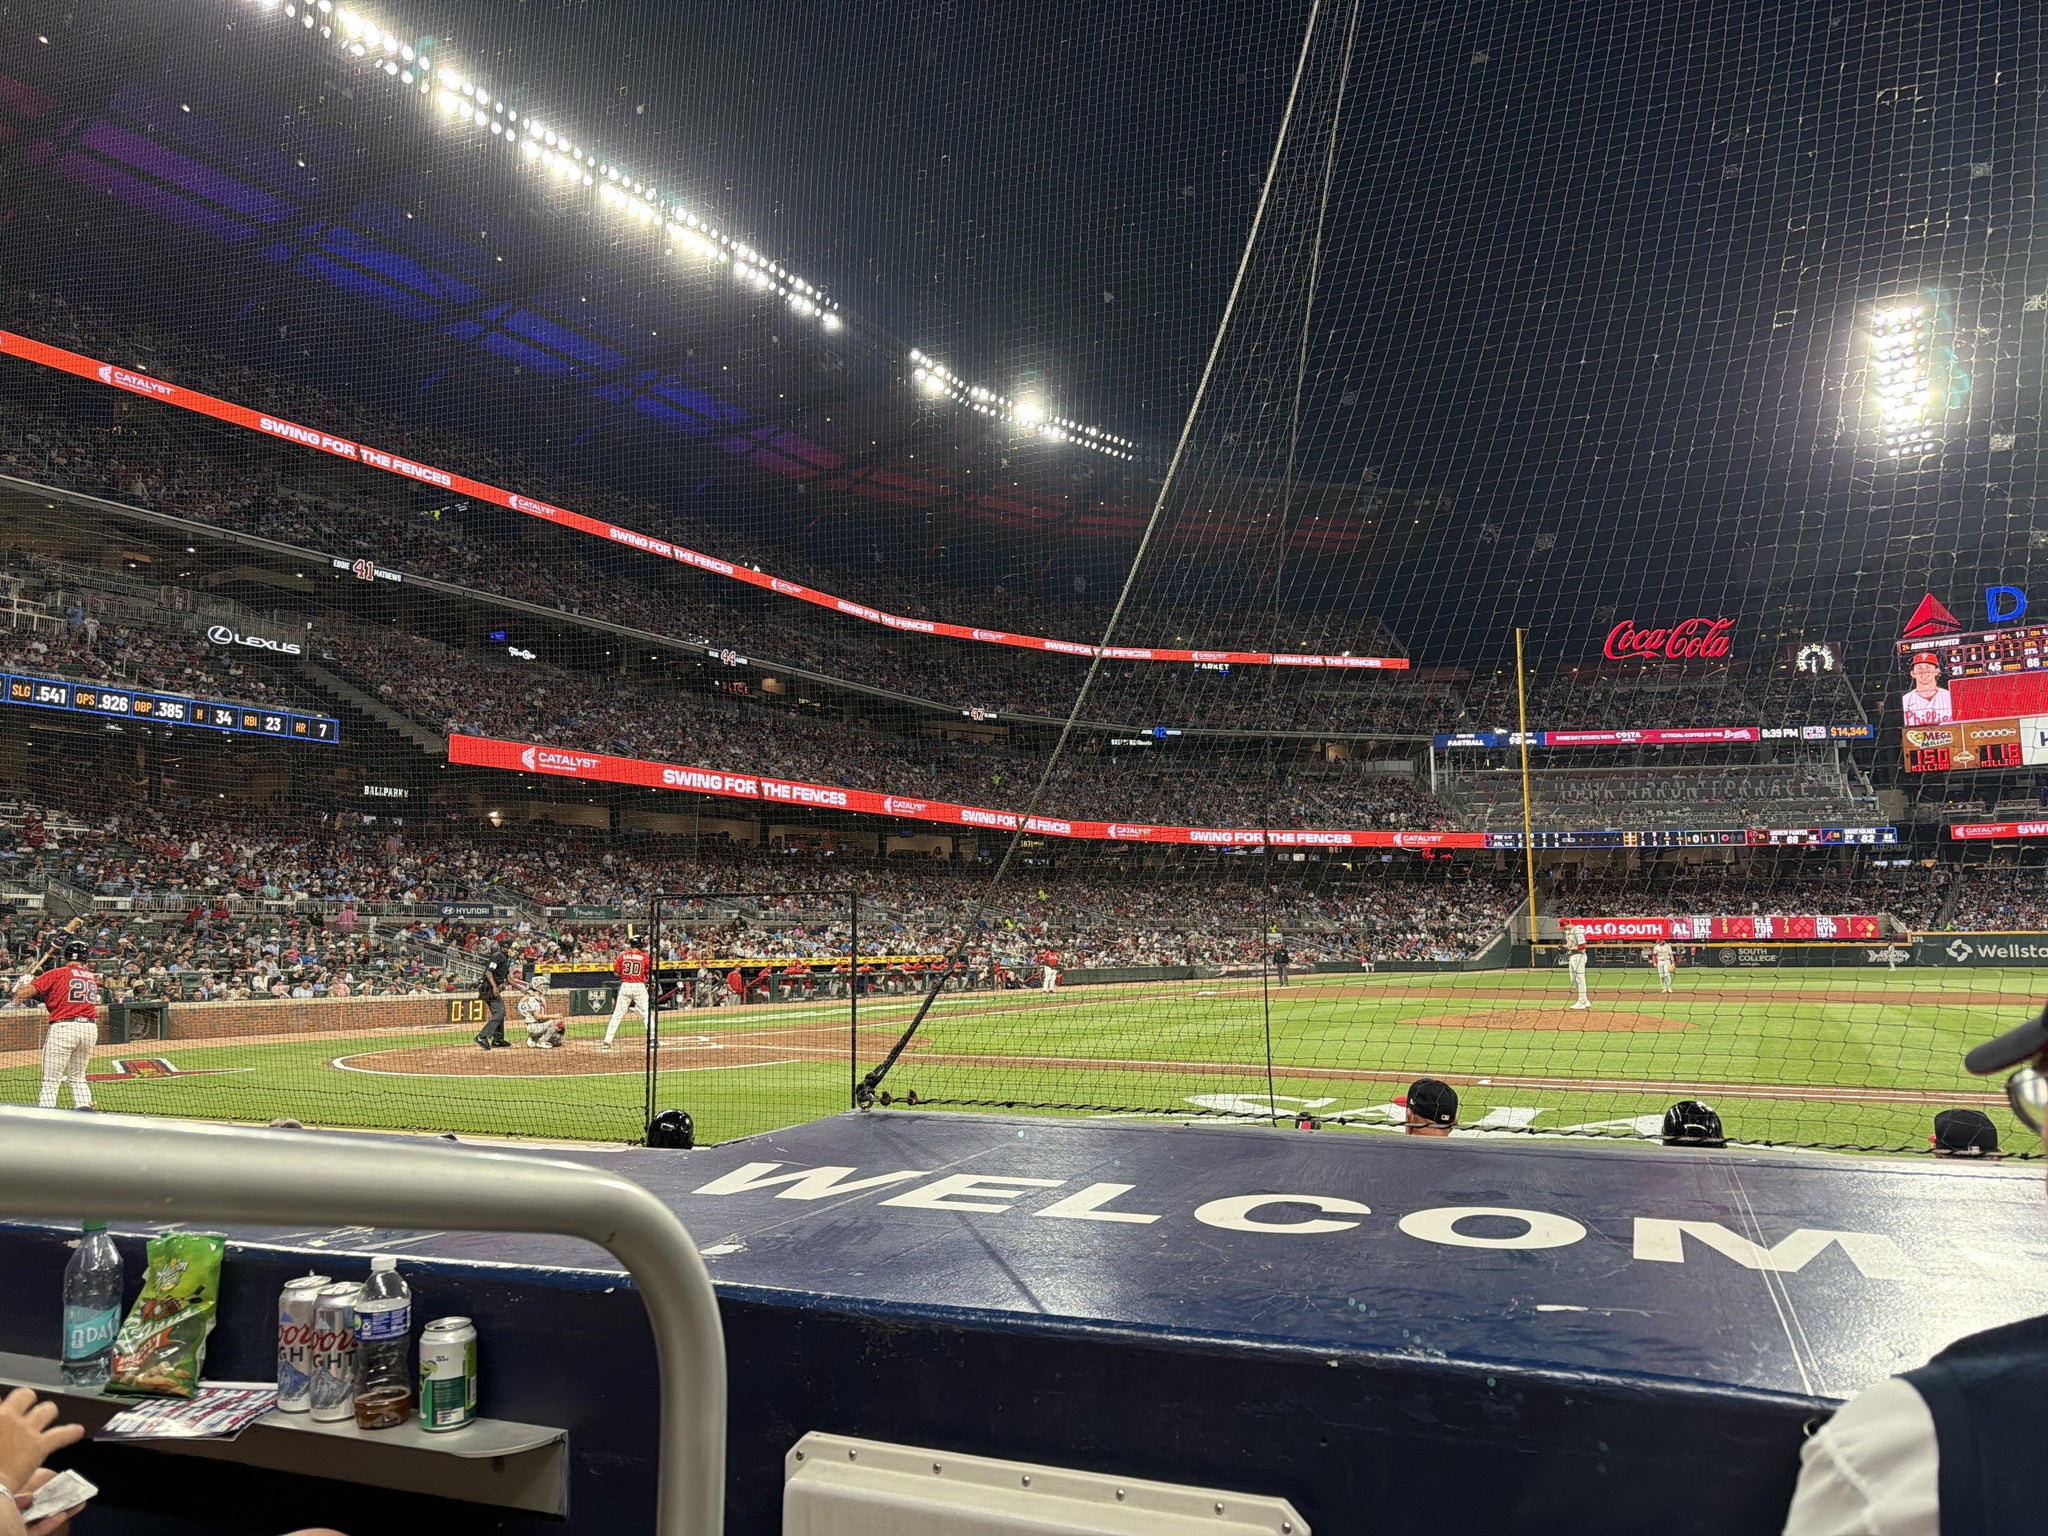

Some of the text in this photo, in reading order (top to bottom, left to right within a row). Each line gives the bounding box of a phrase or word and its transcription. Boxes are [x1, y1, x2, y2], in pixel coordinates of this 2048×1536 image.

[114, 371, 175, 396] CATALYST
[260, 417, 451, 486] SWING FOR THE FENCES
[518, 499, 557, 516] CATALYST
[609, 528, 734, 575] SWING FOR THE FENCES
[352, 558, 375, 582] 41
[1986, 585, 2028, 623] D
[234, 633, 301, 655] LEXUS
[1603, 618, 1736, 660] Coca-Cola
[721, 649, 736, 667] 44
[1988, 662, 2001, 671] 45
[12, 684, 31, 698] SLG
[722, 681, 749, 695] SLICE
[35, 686, 66, 704] .541
[76, 692, 95, 706] OPS
[97, 694, 128, 712] .926
[134, 700, 153, 714] OBP
[154, 702, 184, 719] .385
[196, 708, 203, 720] H
[216, 710, 232, 726] 34
[244, 715, 258, 728] RBI
[266, 716, 281, 731] 23
[295, 722, 306, 734] HR
[319, 723, 327, 738] 7
[1153, 726, 1168, 738] 42
[1761, 728, 1782, 738] 8:39
[1783, 728, 1798, 738] PM
[1830, 726, 1868, 738] $14,344
[1615, 731, 1642, 739] COSTA
[1922, 731, 1952, 742] MEGA
[1447, 739, 1485, 747] FASTBALL
[538, 752, 601, 769] CATALYST
[1917, 749, 1949, 765] 150
[1981, 758, 2021, 768] MILLION
[1911, 764, 1950, 772] MILLION
[364, 785, 403, 797] BALLPARK
[662, 769, 847, 806] SWING FOR THE FENCES
[893, 800, 926, 812] CATALYST
[961, 809, 995, 824] SWING
[996, 814, 1017, 827] FOR
[1037, 820, 1071, 834] FENCES
[1190, 831, 1352, 844] SWING FOR THE FENCES
[1965, 826, 2007, 836] CATALYST
[1403, 834, 1444, 843] CATALYST
[1861, 834, 1875, 843] 82
[456, 907, 490, 915] HYUNDAI
[1693, 917, 1728, 926] BOS 2
[1754, 917, 1789, 926] CLE 7
[1816, 917, 1835, 926] COL
[1576, 923, 1690, 935] GAS SOUTH AL
[1693, 926, 1712, 935] BAL
[1754, 925, 1790, 934] TOR 3
[1816, 925, 1837, 934] NYM
[623, 961, 643, 976] 30
[68, 979, 98, 1003] 28
